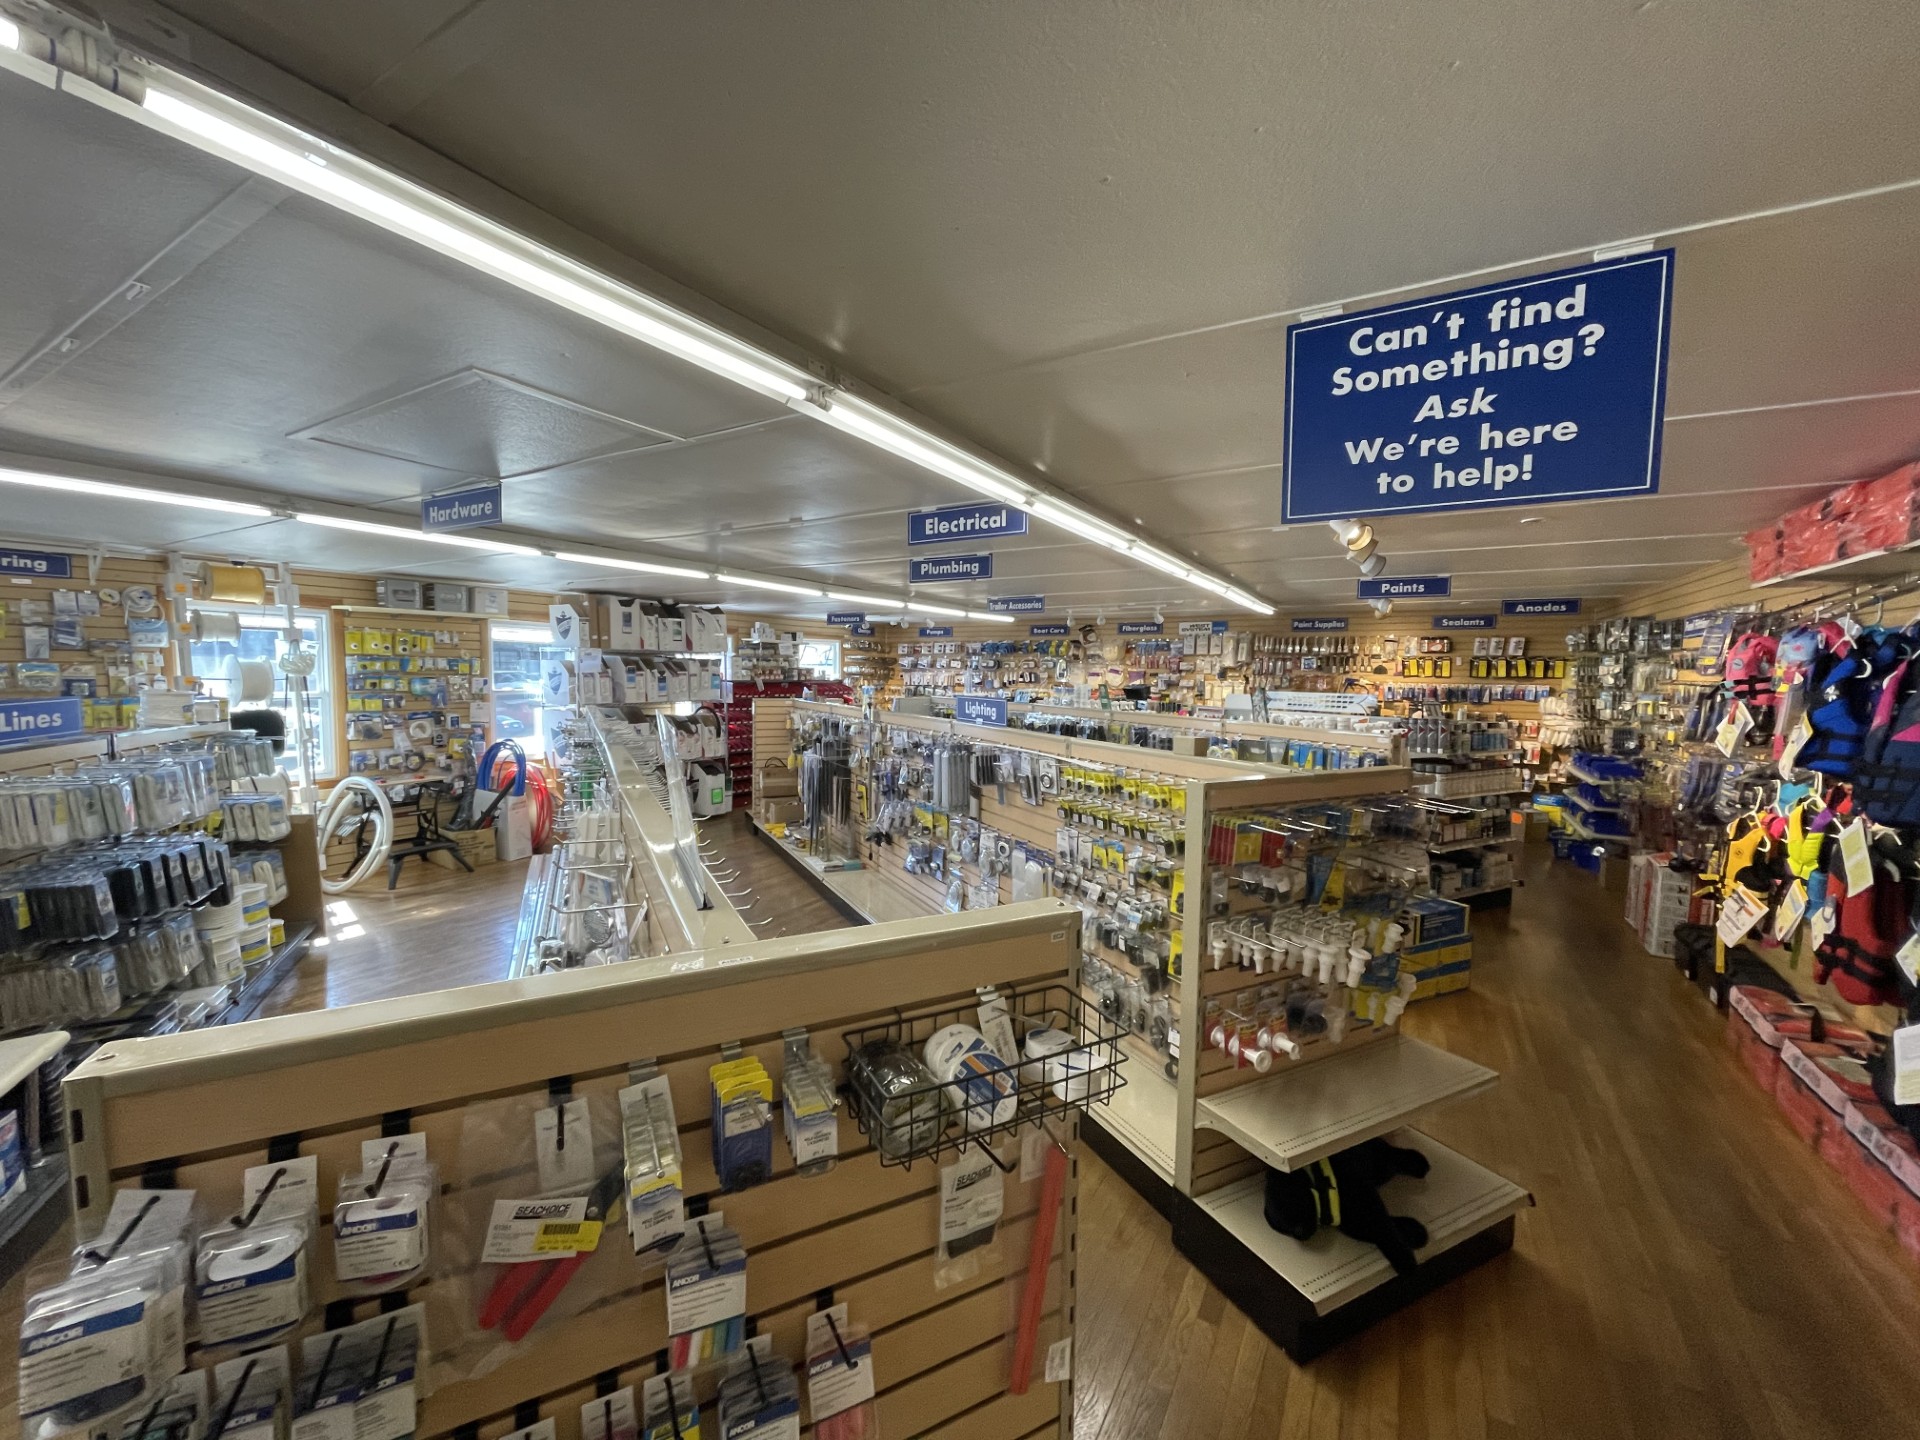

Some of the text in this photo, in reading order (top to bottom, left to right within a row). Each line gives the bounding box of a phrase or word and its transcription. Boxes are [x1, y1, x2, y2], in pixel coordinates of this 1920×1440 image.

[1349, 283, 1587, 356] Can't find
[1332, 323, 1605, 397] Something?
[1413, 387, 1498, 423] Ask
[1345, 421, 1579, 465] We're here
[1377, 454, 1533, 495] to help!
[429, 501, 493, 524] Hardware
[925, 509, 1007, 536] Electrical
[920, 561, 980, 576] Plumbing
[1381, 582, 1425, 594] Paints
[989, 600, 1042, 611] Trailer Accessories
[1515, 603, 1567, 613] Anodes
[1122, 623, 1158, 633] Fiberglass
[1293, 620, 1346, 630] Paint Supplies
[1442, 618, 1485, 627] Sealants
[965, 701, 997, 720] Lighting
[0, 711, 63, 733] Lines
[515, 1202, 573, 1216] SEACHOICE
[672, 1273, 701, 1289] ANCOR
